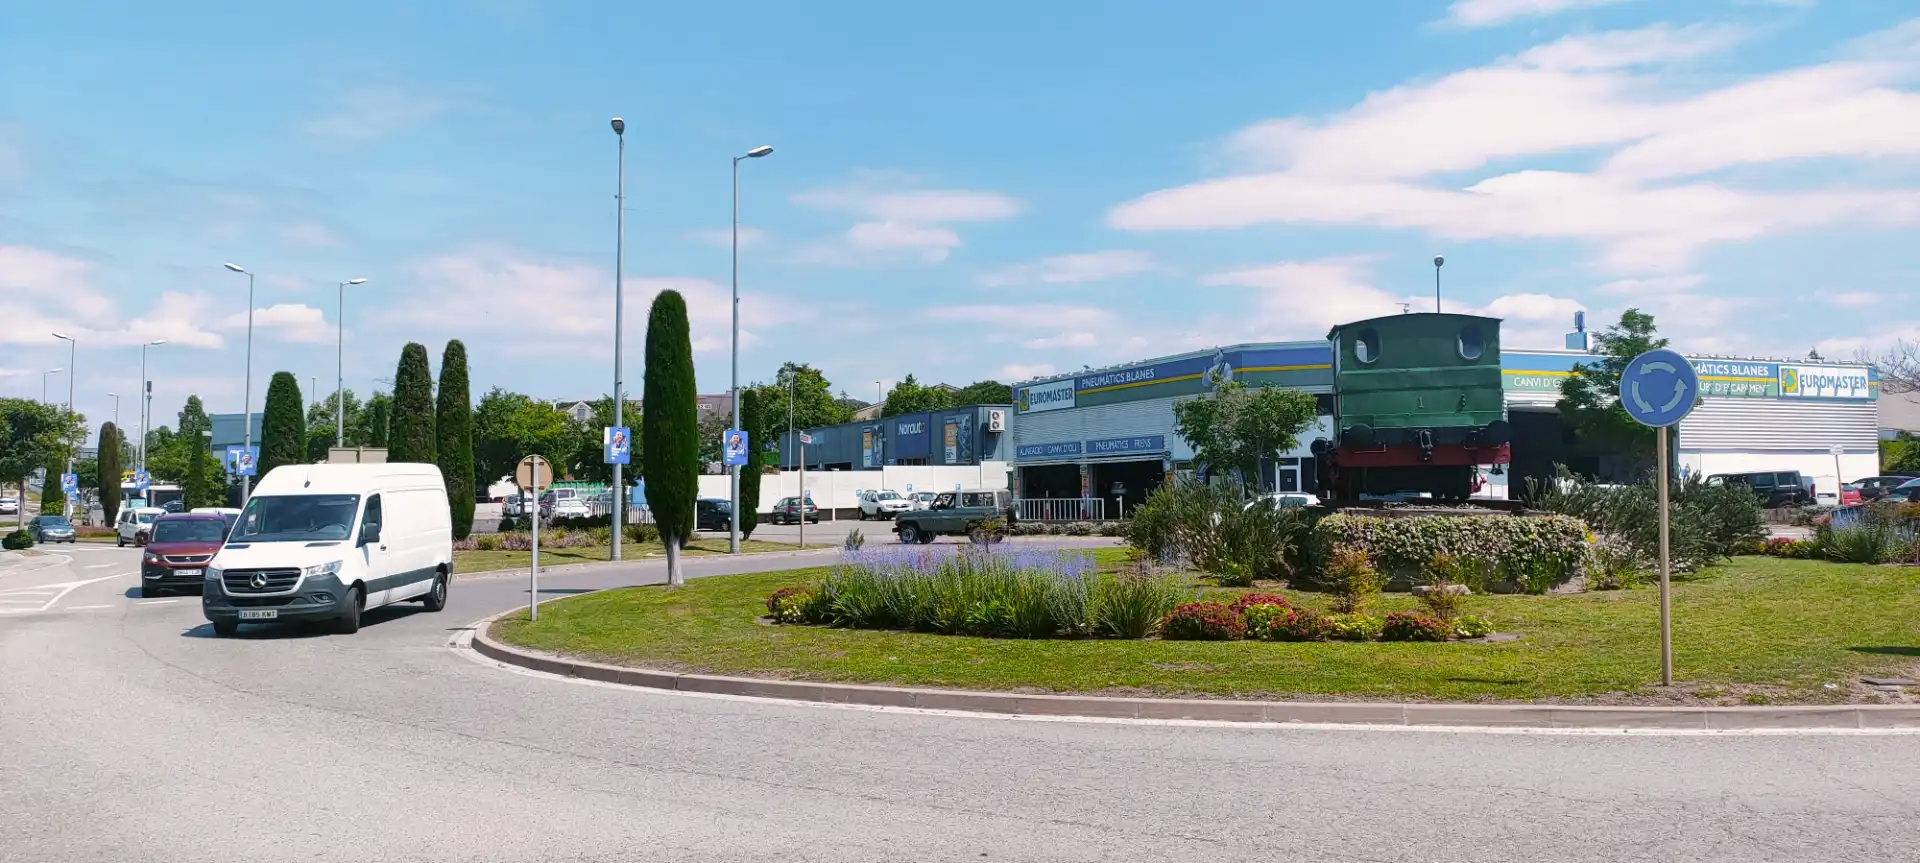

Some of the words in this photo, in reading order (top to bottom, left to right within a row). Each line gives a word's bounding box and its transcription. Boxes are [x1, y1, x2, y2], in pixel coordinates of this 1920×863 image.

[1126, 368, 1155, 381] BLANES
[1731, 364, 1769, 376] BLANES
[1514, 377, 1541, 387] CANVI
[1799, 374, 1867, 389] EUROMASTER
[1030, 387, 1073, 405] EUROMASTER
[898, 421, 926, 435] Norauto
